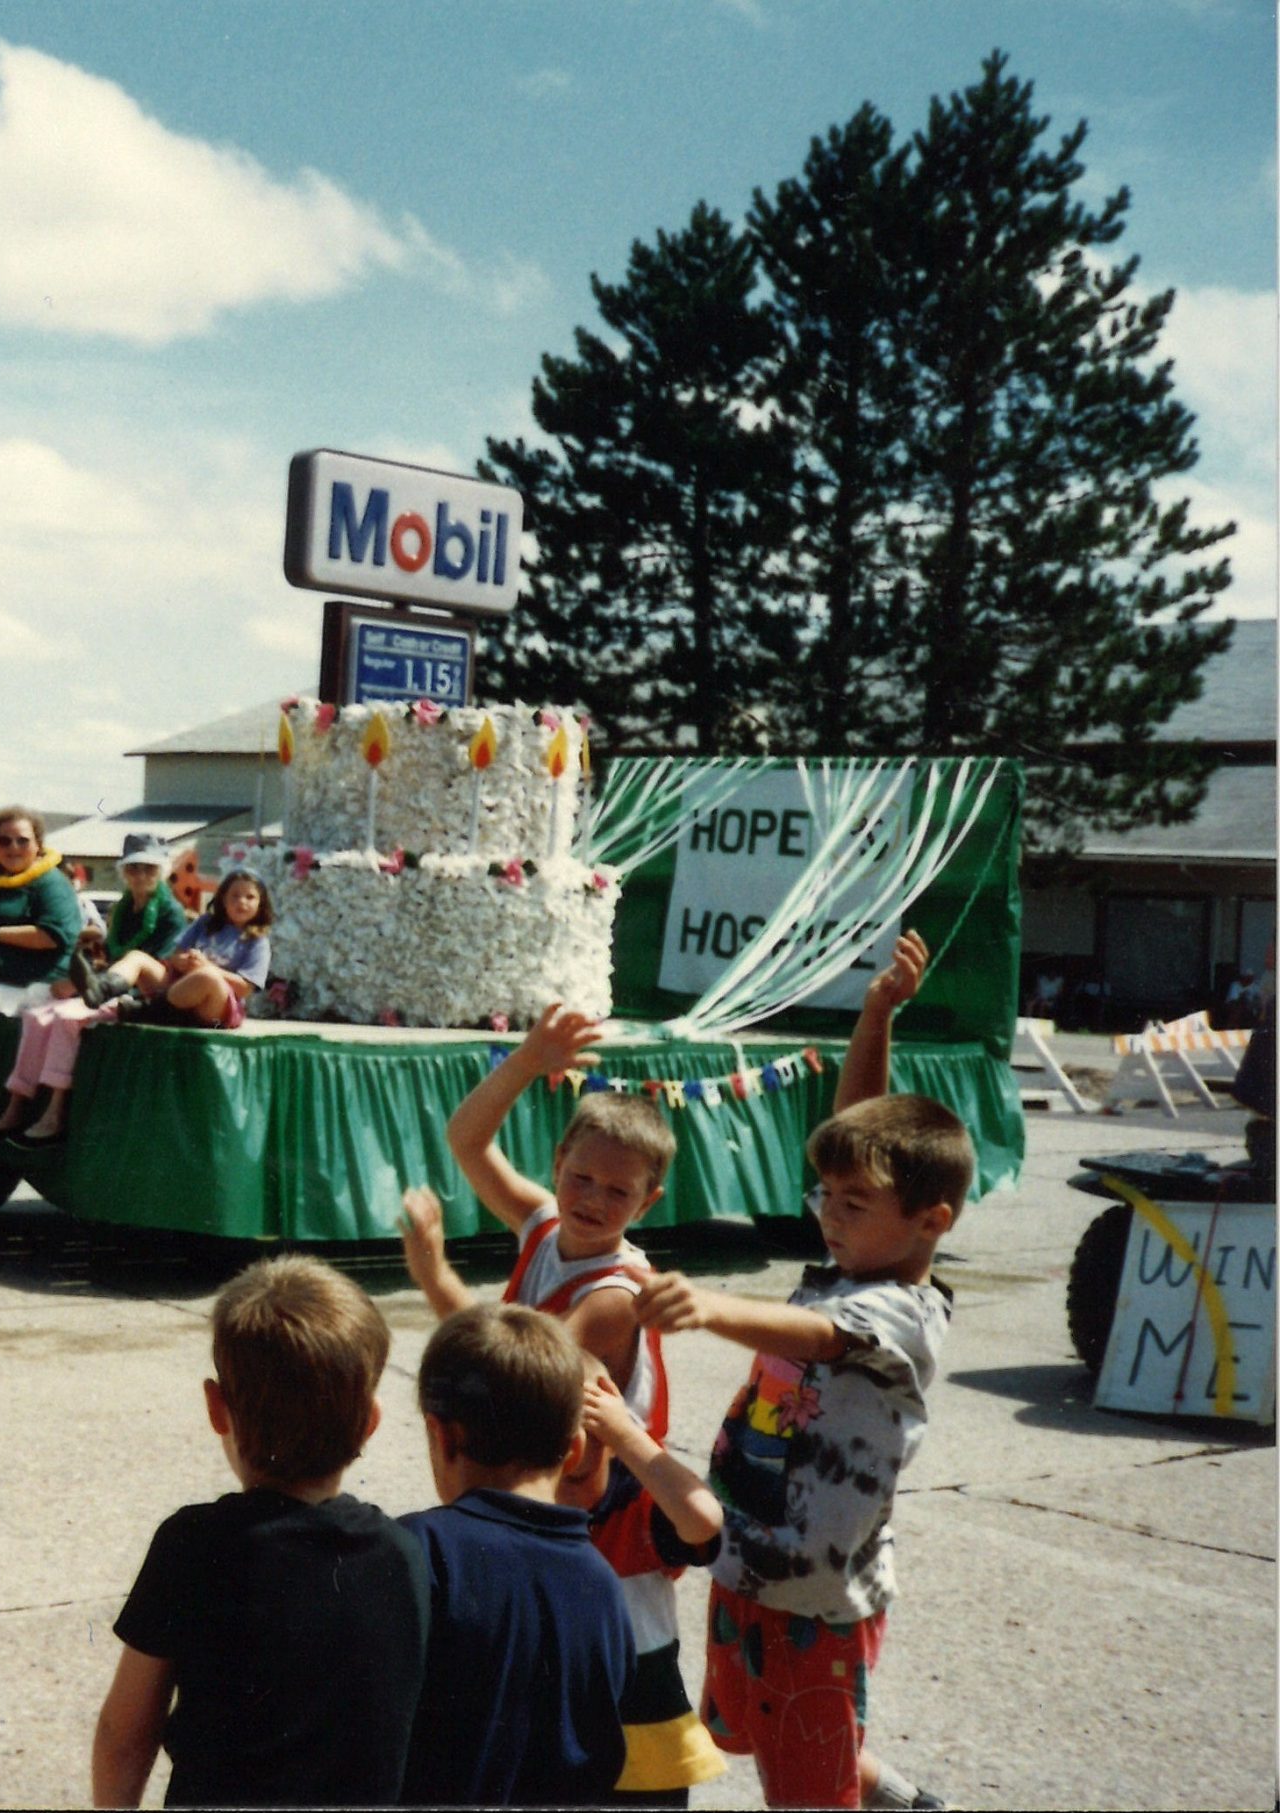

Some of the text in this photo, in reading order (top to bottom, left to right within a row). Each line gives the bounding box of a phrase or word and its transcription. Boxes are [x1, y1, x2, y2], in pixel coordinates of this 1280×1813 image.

[329, 481, 509, 586] Mobil
[690, 808, 810, 857] HOPE
[1138, 1228, 1276, 1290] WIN
[1129, 1318, 1263, 1402] ME
